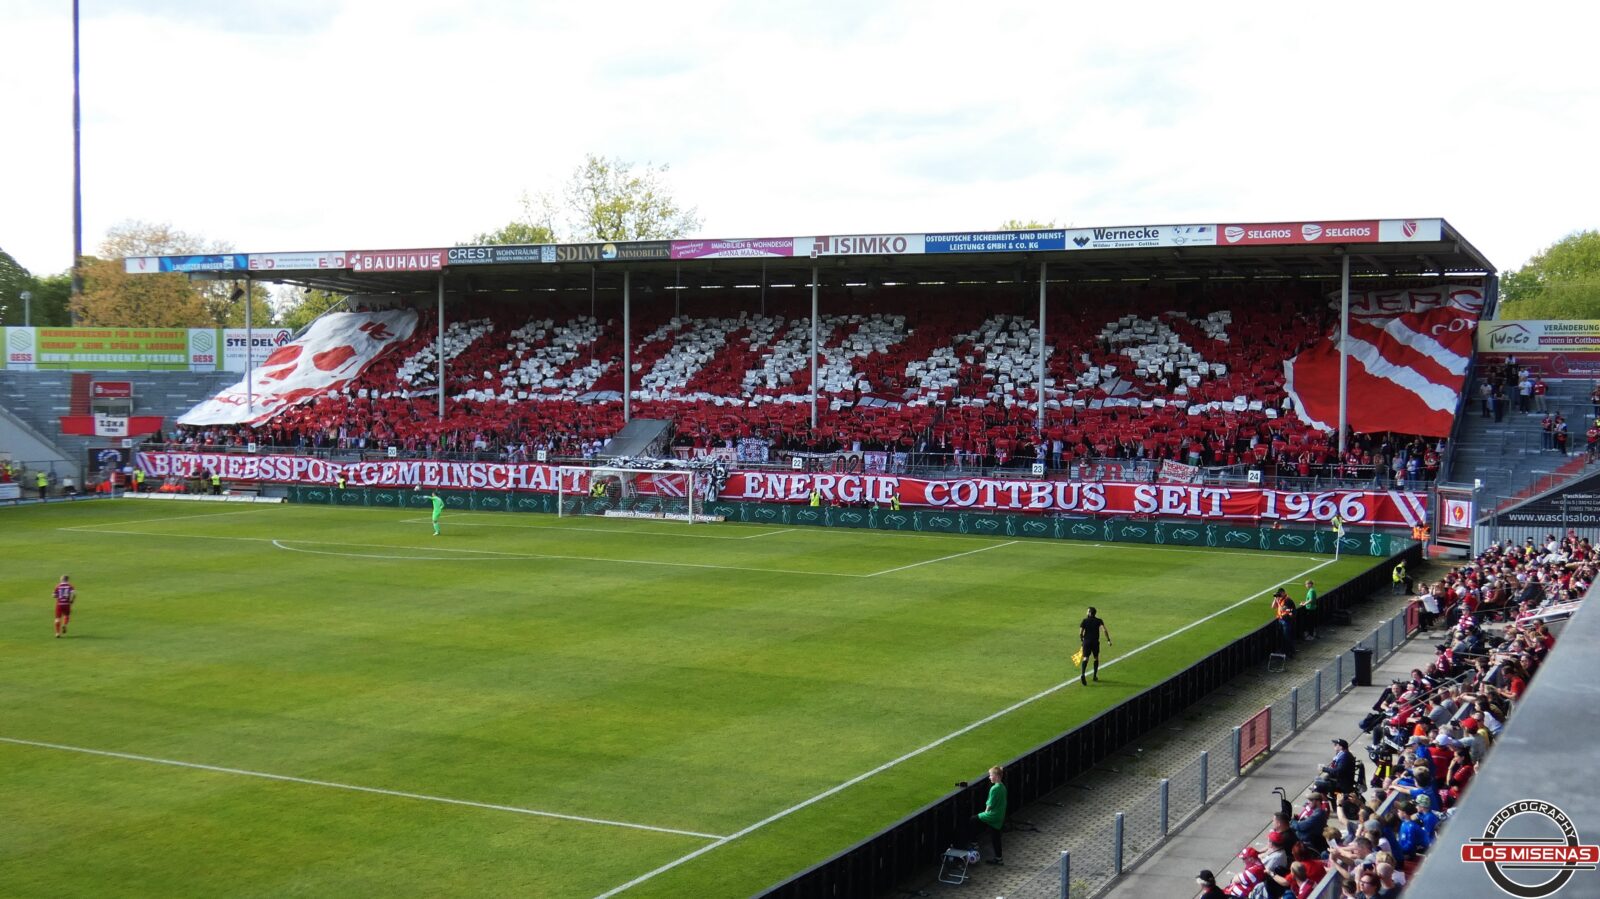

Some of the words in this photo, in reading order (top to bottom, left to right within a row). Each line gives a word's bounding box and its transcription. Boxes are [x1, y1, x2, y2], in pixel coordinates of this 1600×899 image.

[926, 234, 971, 242] OSTDEUTSCHE
[972, 232, 1018, 242] SICHERHEITS-
[1020, 232, 1036, 240] UND
[1037, 232, 1064, 240] DIENST-
[1093, 227, 1160, 240] Wernecke
[1248, 230, 1292, 239] SELGROS
[1325, 228, 1370, 237] SELGROS
[834, 236, 907, 254] ISIMKO
[950, 242, 985, 250] LEISTUNGS
[986, 242, 1007, 250] GMBH
[1015, 242, 1027, 250] CO.
[1028, 241, 1039, 250] KG
[448, 248, 494, 259] CREST
[556, 245, 599, 261] SDIM
[618, 248, 670, 258] IMMOBILIEN
[364, 254, 441, 270] BAUHAUS
[154, 454, 586, 492] BETRIEBSSPORTGEMEINSCHAFT
[1033, 465, 1042, 474] 23
[1249, 472, 1258, 481] 24
[742, 472, 900, 503] ENERGIE
[924, 479, 1106, 512] COTTBUS
[1134, 484, 1230, 516] SEIT
[1260, 490, 1366, 523] 1966
